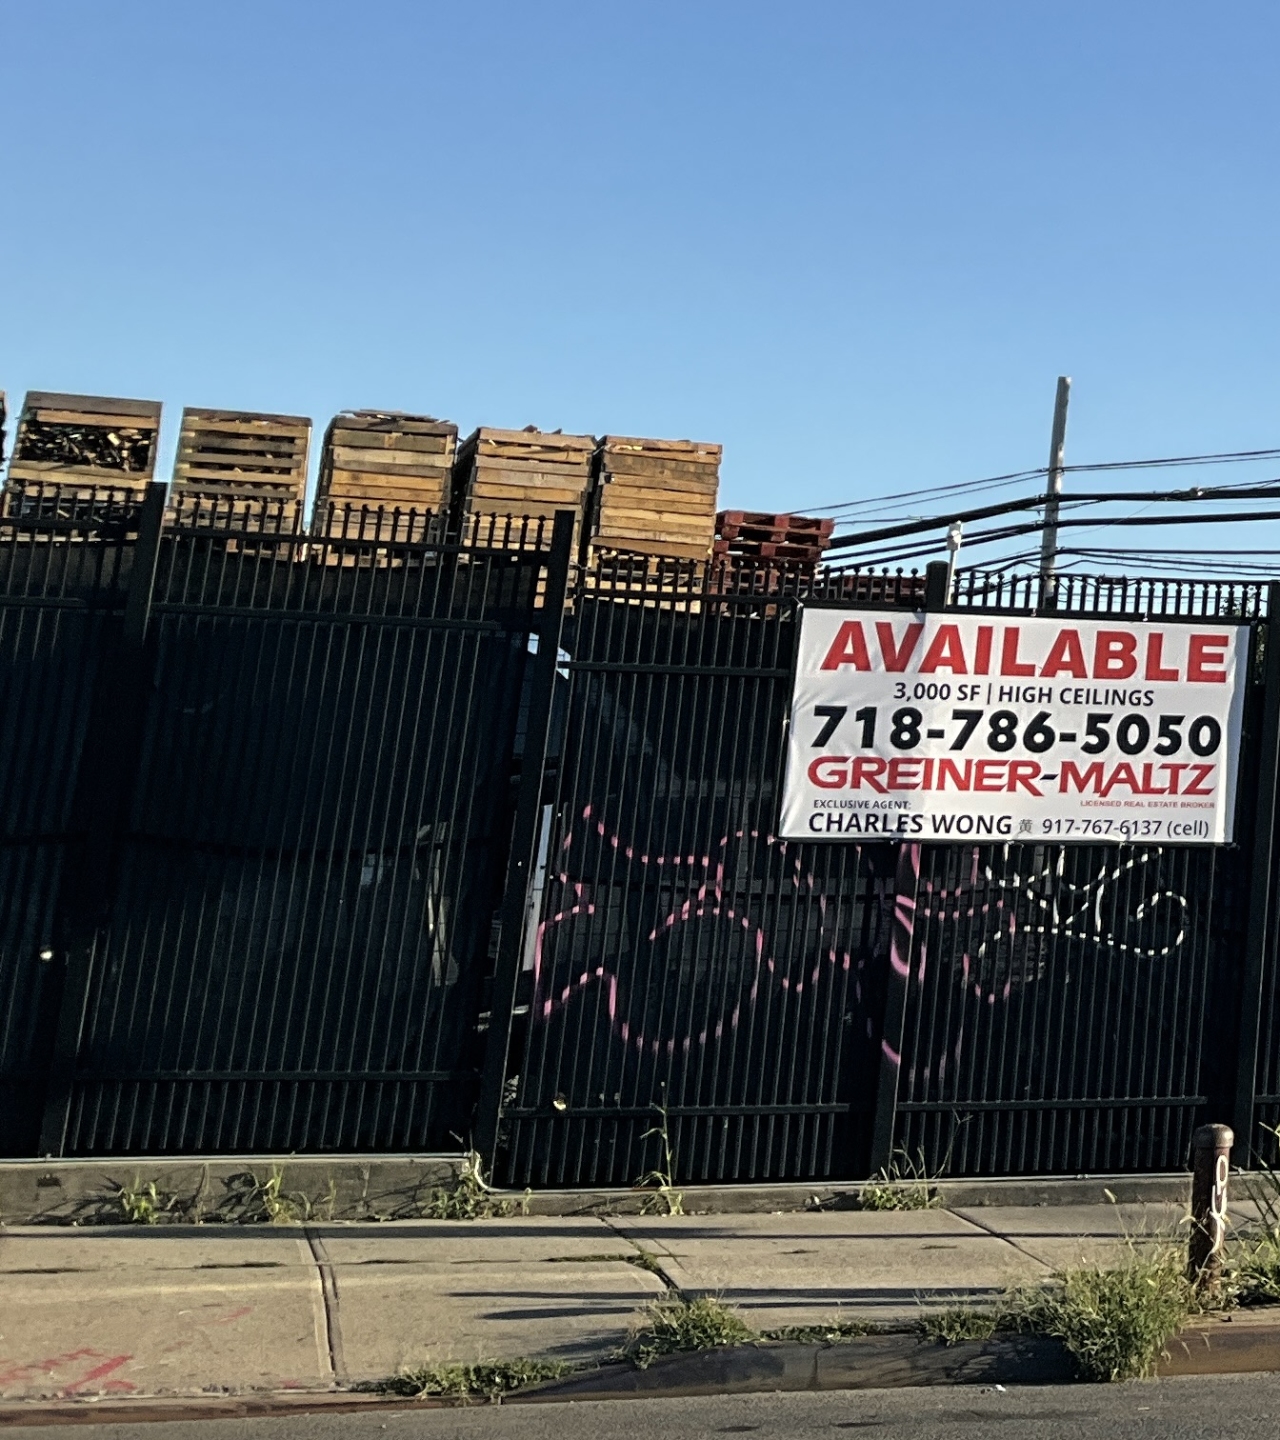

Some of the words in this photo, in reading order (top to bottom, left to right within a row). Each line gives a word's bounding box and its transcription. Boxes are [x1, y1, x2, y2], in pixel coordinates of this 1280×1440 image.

[820, 620, 1230, 684] AVAILABLE
[893, 682, 951, 702] 3,000
[957, 684, 981, 701] SF
[998, 686, 1052, 704] HIGH
[1059, 687, 1154, 707] CEILINGS
[811, 705, 1222, 757] 718-786-5050
[807, 755, 1216, 798] GREINER-MALTZ
[813, 799, 869, 809] EXCLUSIVE
[872, 800, 911, 810] AGENT:
[1123, 800, 1145, 808] REAL
[1180, 801, 1215, 809] BROKER
[809, 812, 923, 833] CHARLES
[931, 814, 1012, 835] WONG
[1042, 818, 1162, 835] 917-767-6137
[1167, 820, 1209, 838] (cell)
